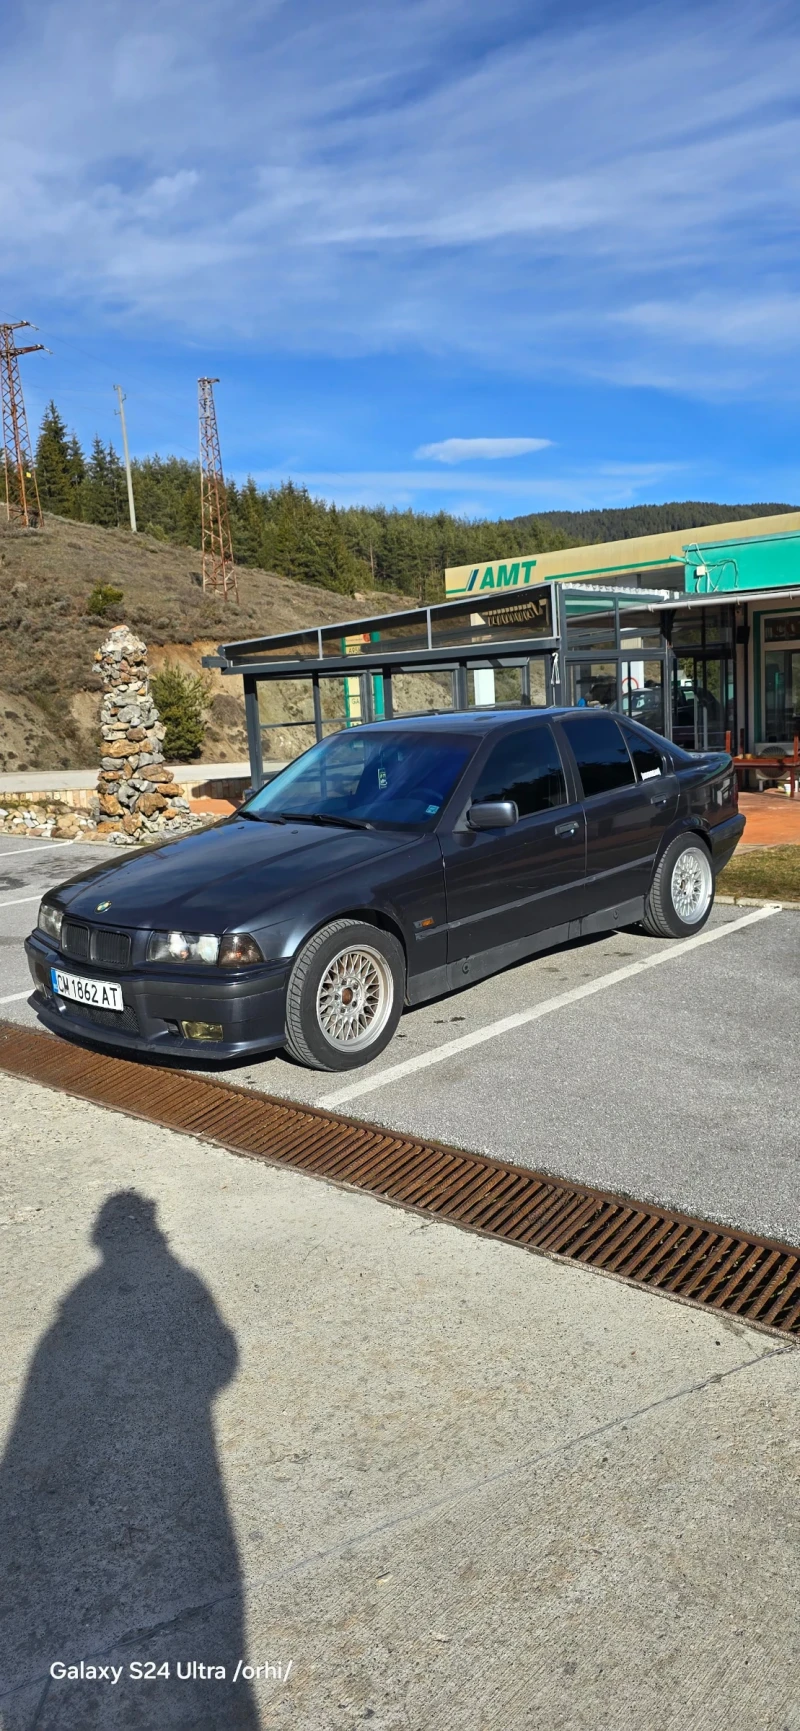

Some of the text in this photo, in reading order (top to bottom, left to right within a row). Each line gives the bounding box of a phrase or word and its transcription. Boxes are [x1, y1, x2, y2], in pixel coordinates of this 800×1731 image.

[479, 560, 537, 590] AMT
[57, 974, 118, 1007] CM 1862 AT
